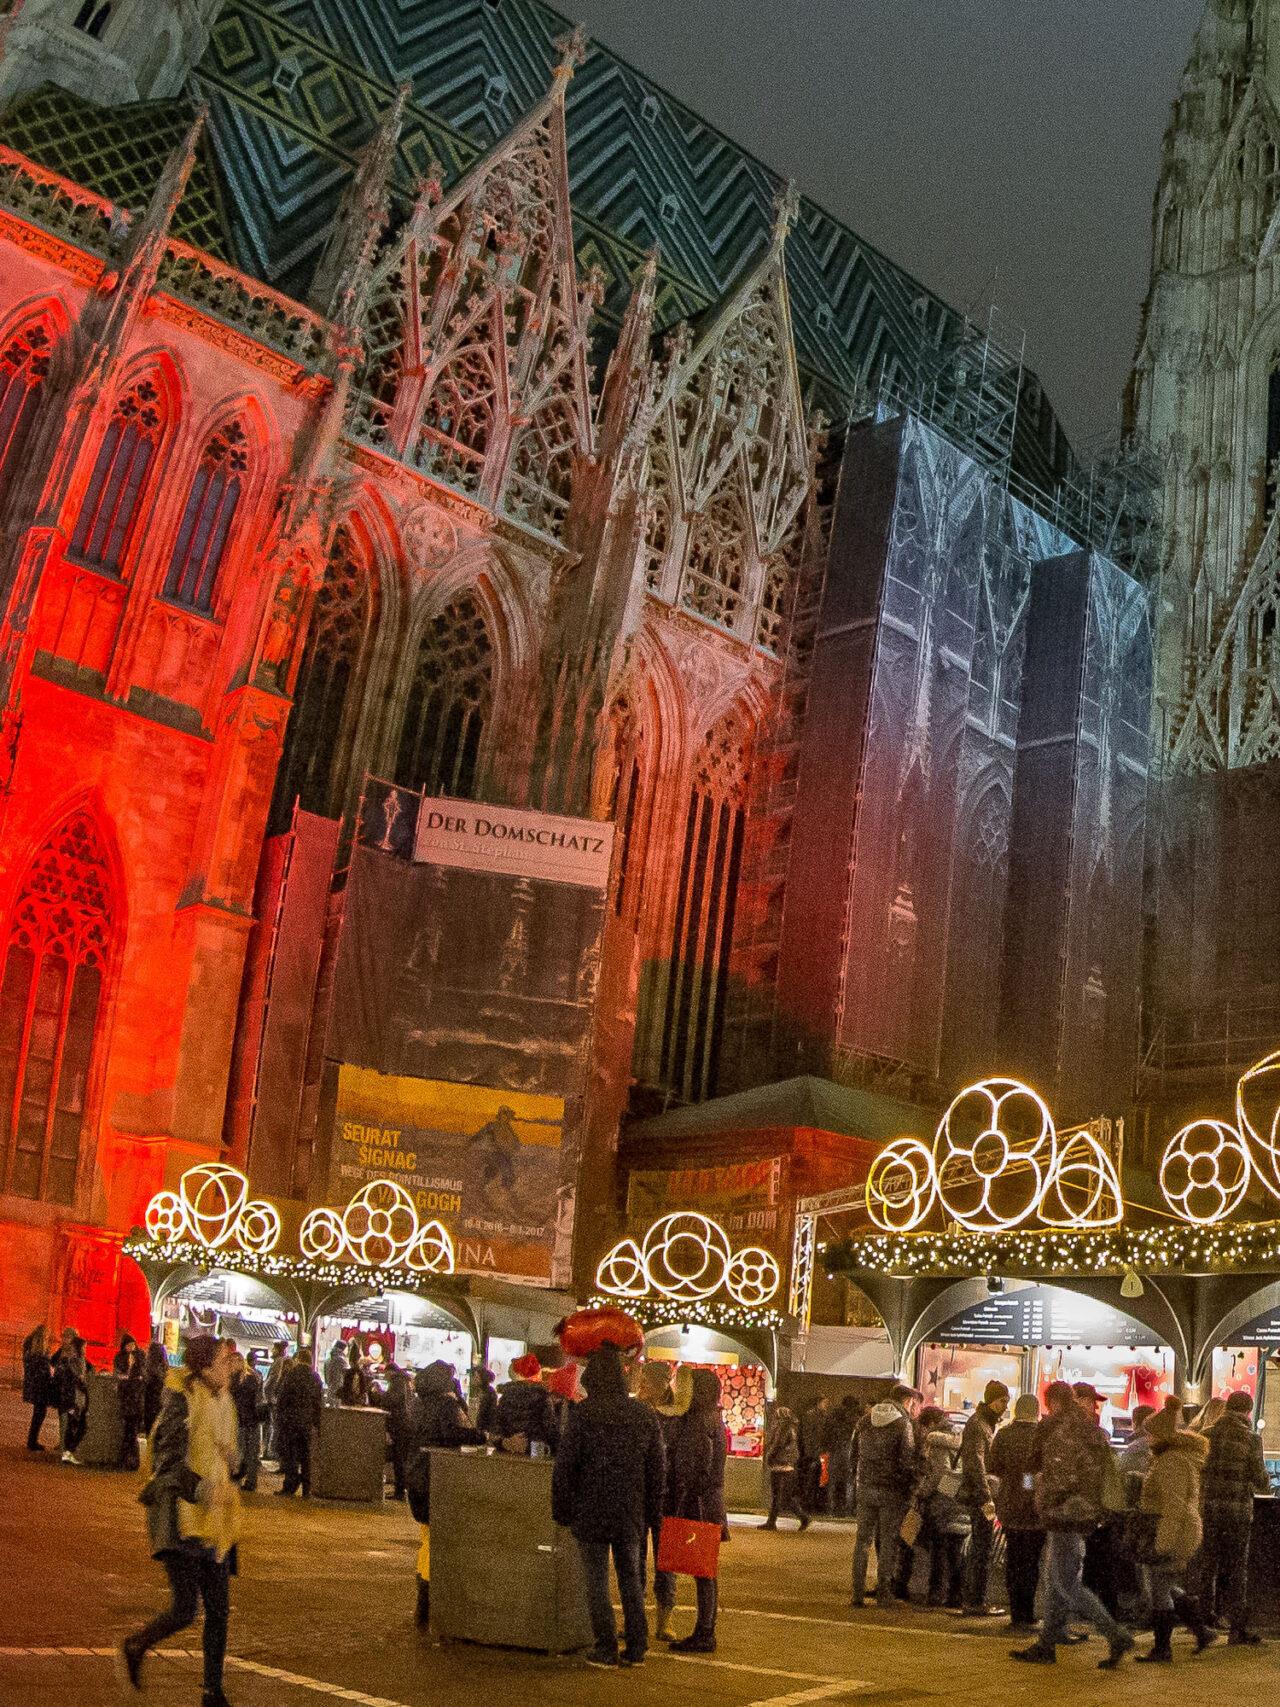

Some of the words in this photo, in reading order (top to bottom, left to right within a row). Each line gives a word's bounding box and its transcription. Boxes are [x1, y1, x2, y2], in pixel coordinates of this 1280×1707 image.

[474, 819, 605, 853] DOMSCHATZ
[342, 1122, 401, 1148] SEURAT
[358, 1145, 417, 1170] SIGNAC
[416, 1191, 461, 1213] GOGH
